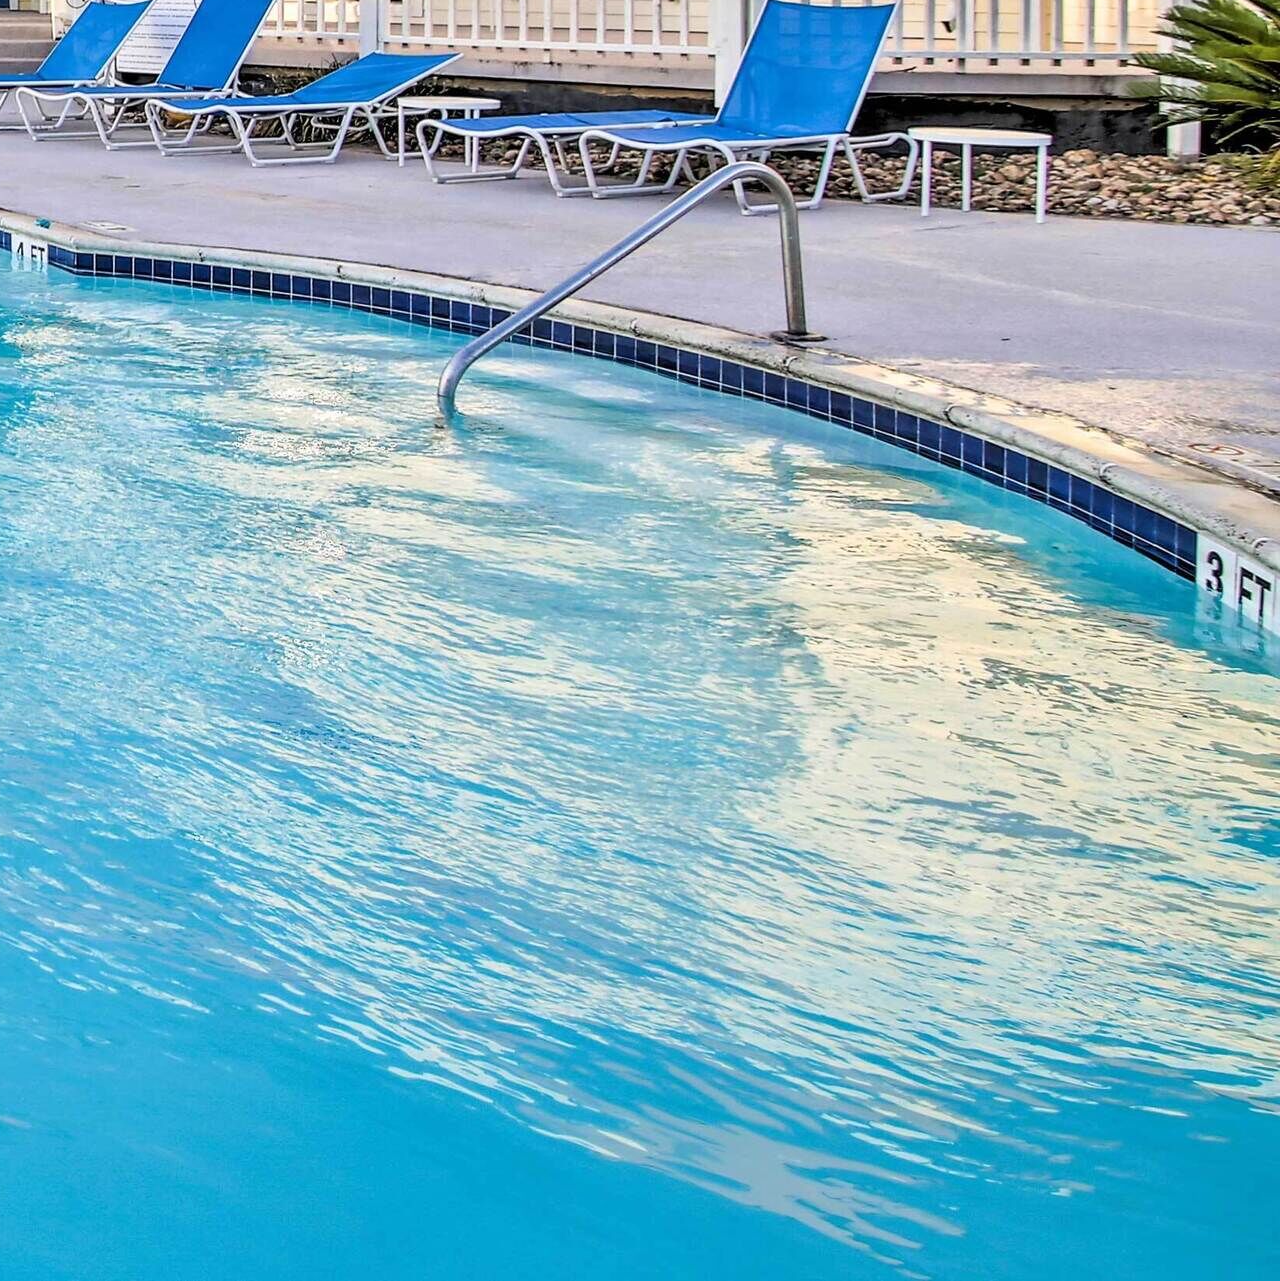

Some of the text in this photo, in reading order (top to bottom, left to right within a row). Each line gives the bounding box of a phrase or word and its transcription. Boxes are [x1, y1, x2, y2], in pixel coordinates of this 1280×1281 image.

[31, 245, 45, 261] FT
[1206, 551, 1272, 618] 3 FT
